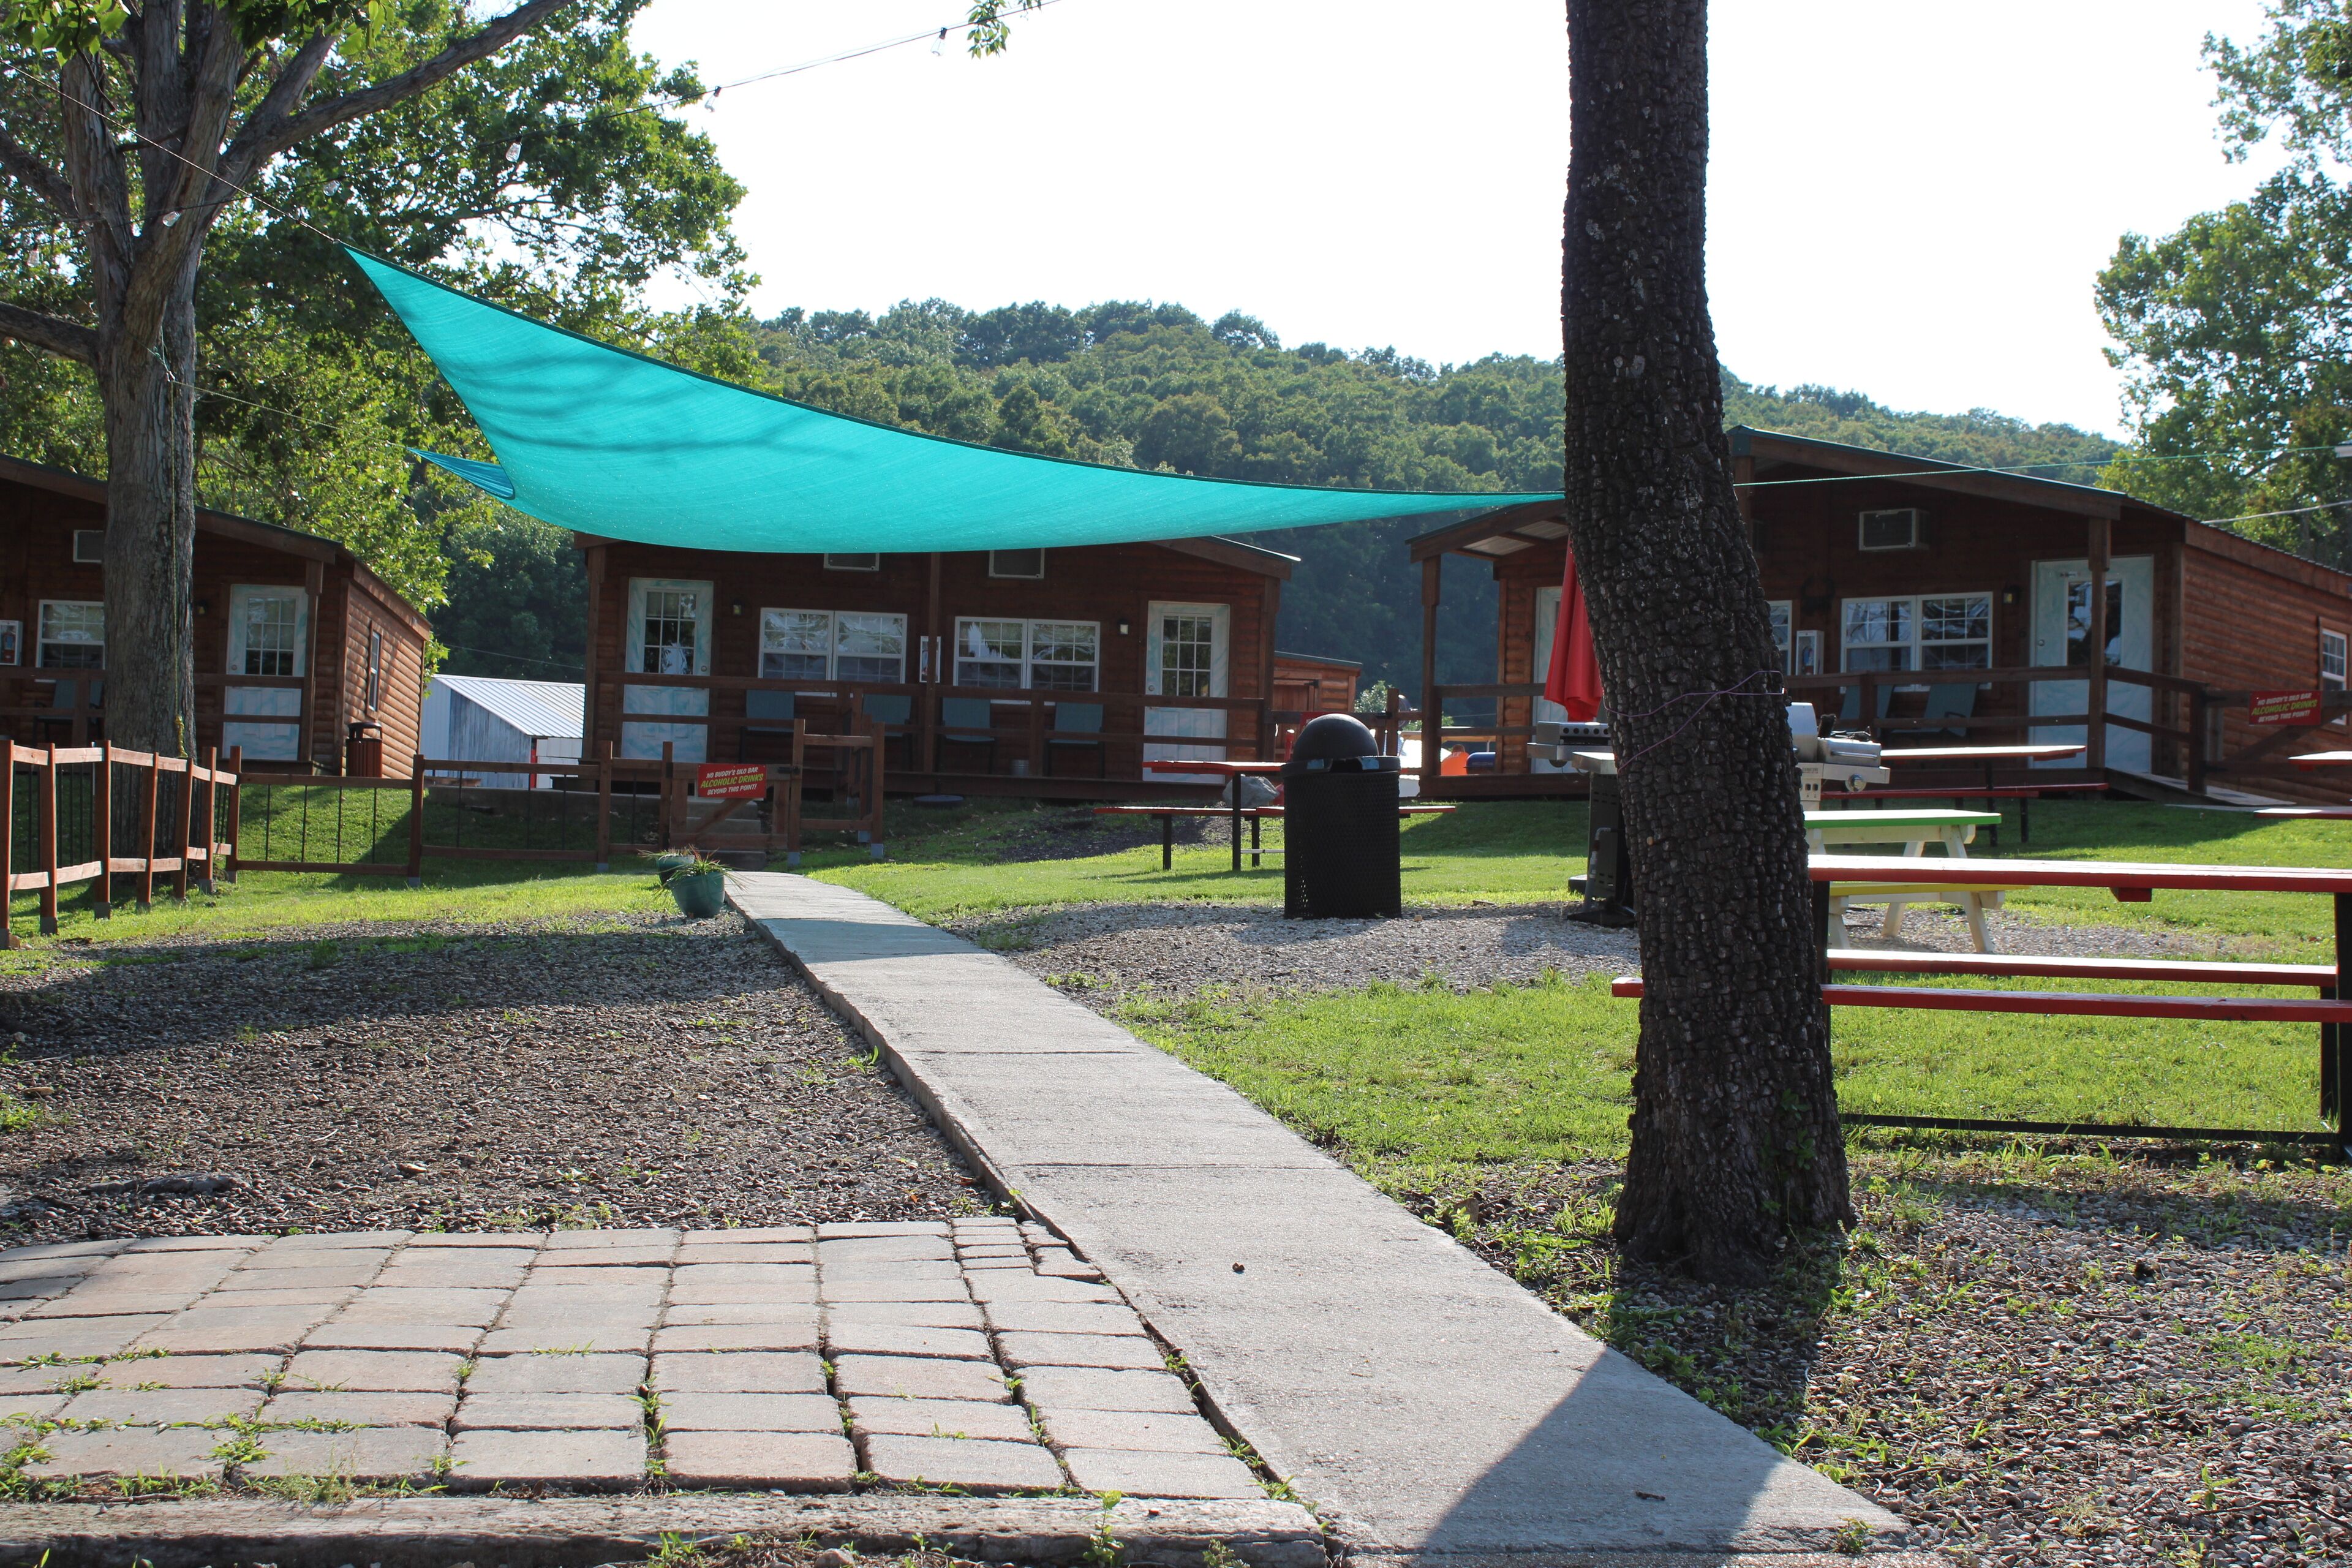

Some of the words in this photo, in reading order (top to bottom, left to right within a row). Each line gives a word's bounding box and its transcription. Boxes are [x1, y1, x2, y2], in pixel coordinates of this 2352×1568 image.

[2251, 703, 2290, 715] ALCOHOLIC
[2291, 699, 2318, 710] DRINKS
[715, 769, 736, 778] BUDDY'S
[700, 777, 737, 788] ALCOHOLIC
[738, 774, 764, 784] DRINKS
